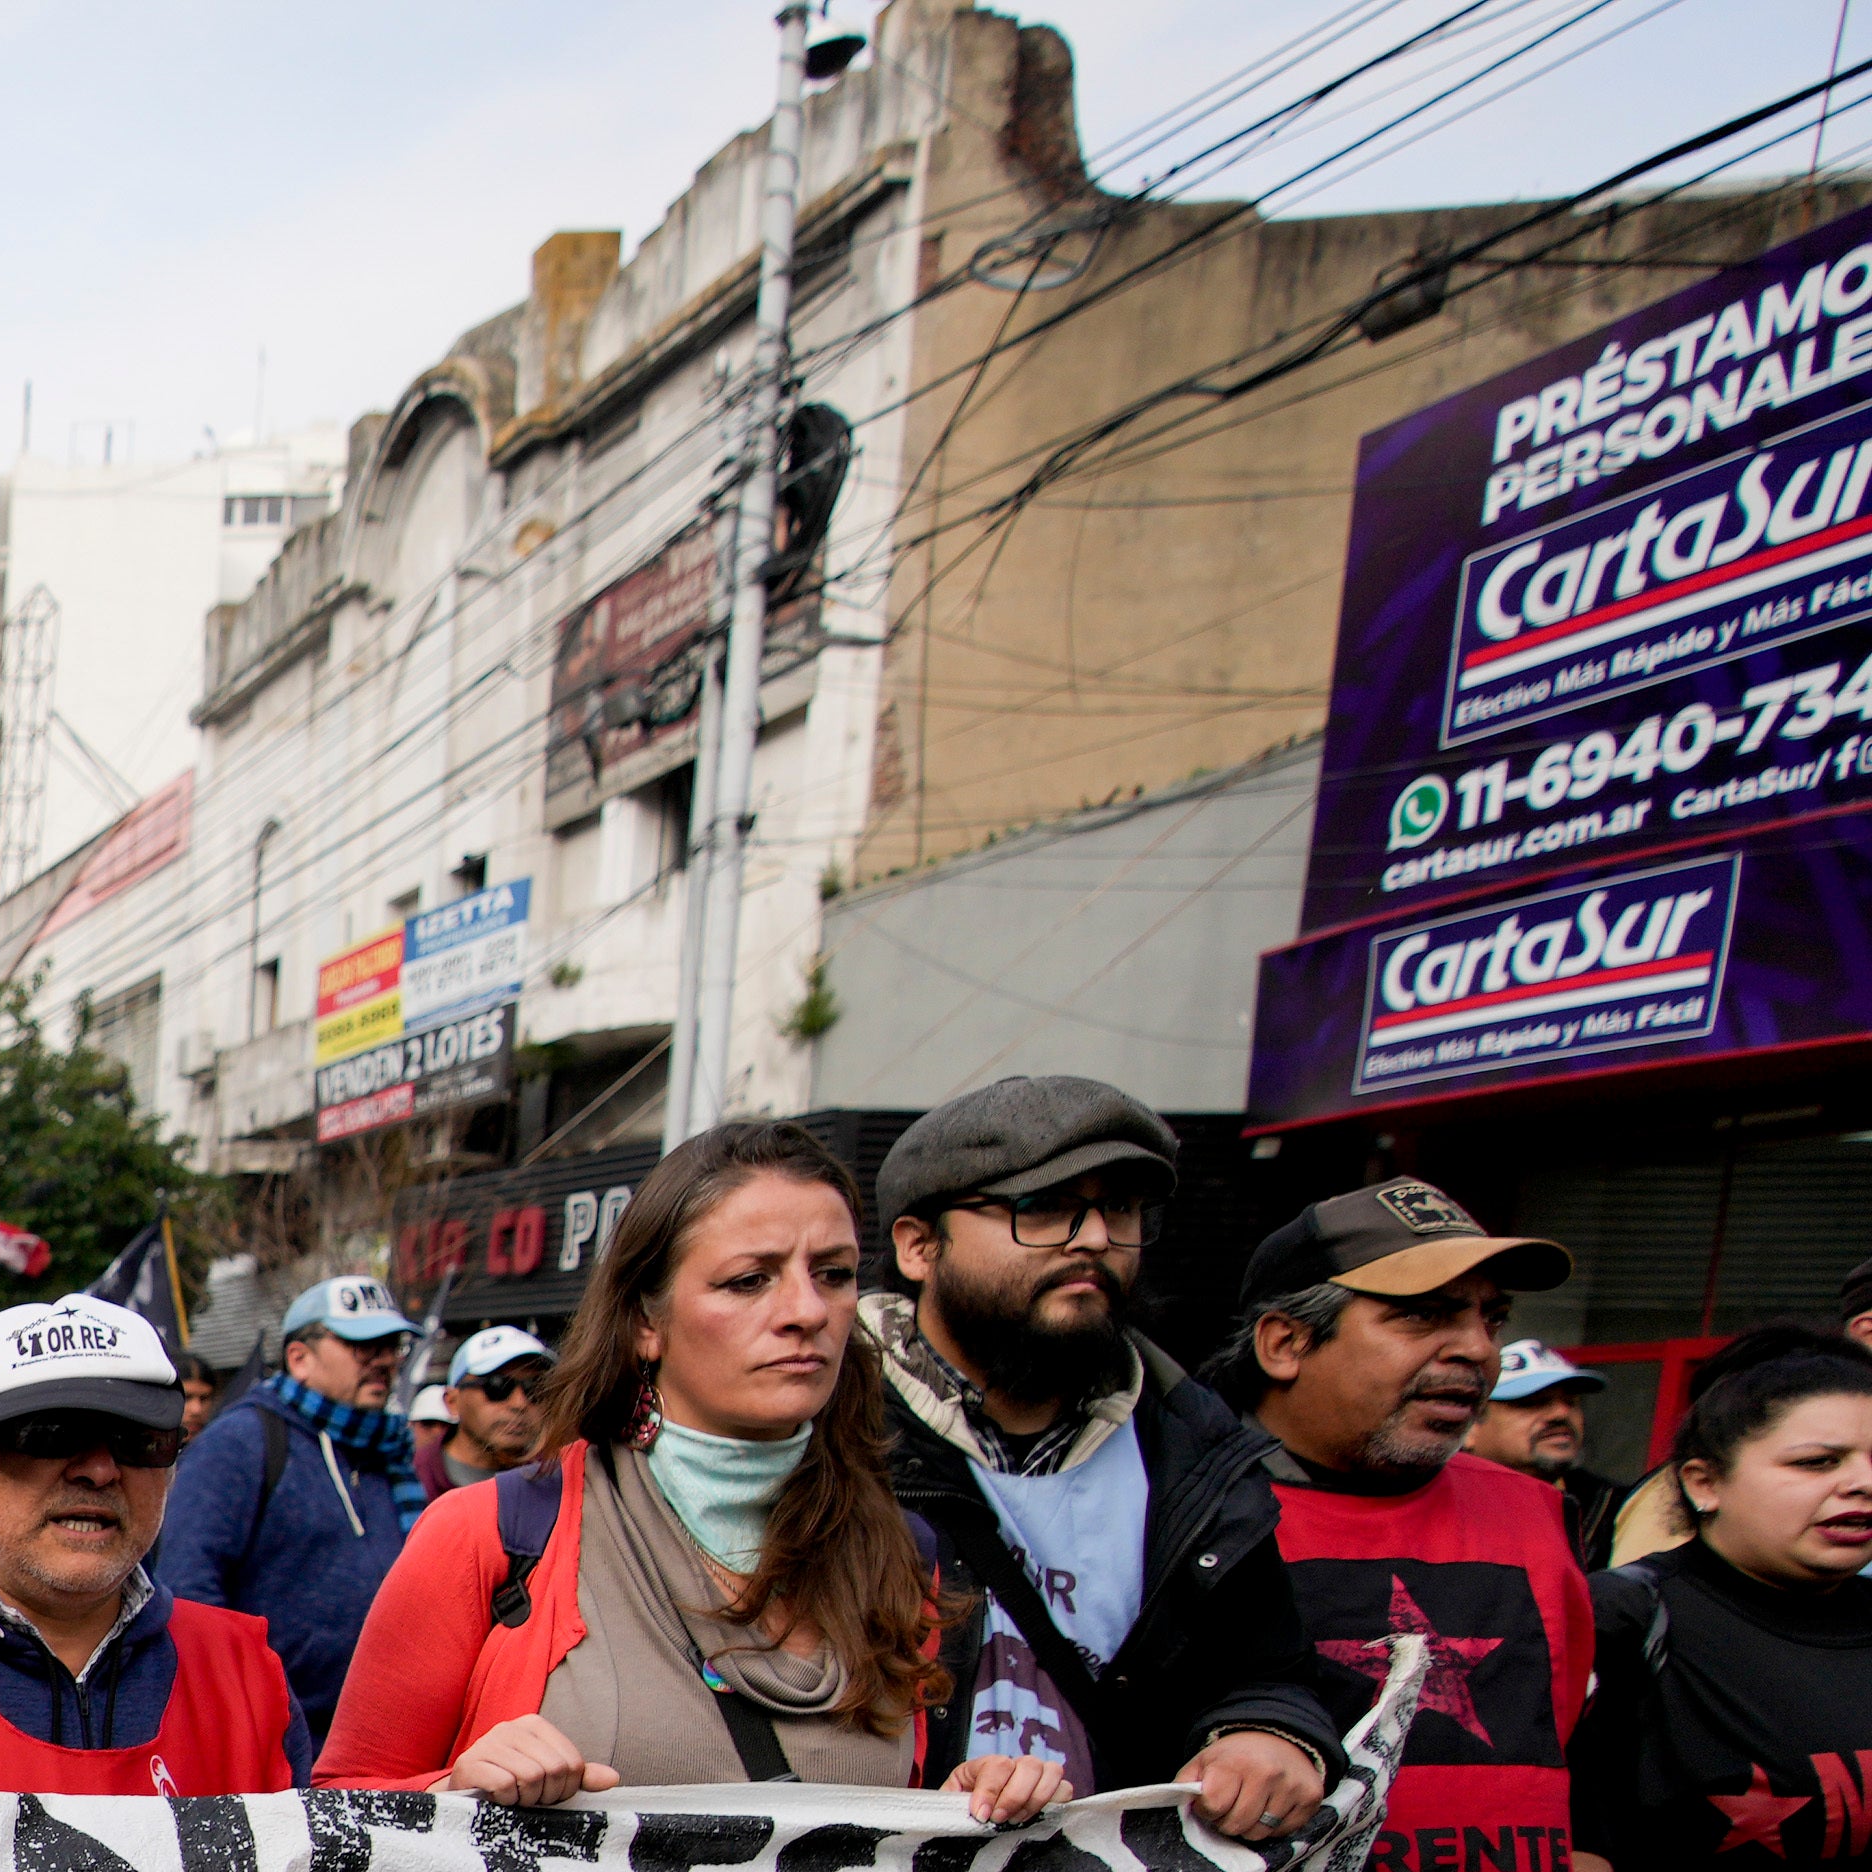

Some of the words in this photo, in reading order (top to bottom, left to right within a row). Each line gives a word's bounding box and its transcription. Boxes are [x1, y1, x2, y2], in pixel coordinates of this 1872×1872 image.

[1455, 678, 1552, 729] Efectivo
[1553, 657, 1608, 697] Más
[1610, 624, 1715, 679] Rápido
[1713, 615, 1740, 653] y
[1743, 593, 1804, 637] Más
[1380, 799, 1653, 892] cartasur.com.ar
[1382, 887, 1714, 1012] CartaSur
[404, 1038, 423, 1080] 2
[424, 1005, 506, 1072] LOTES
[1558, 1018, 1582, 1049] y
[1582, 1008, 1635, 1038] Más
[1635, 995, 1704, 1032] Fácil
